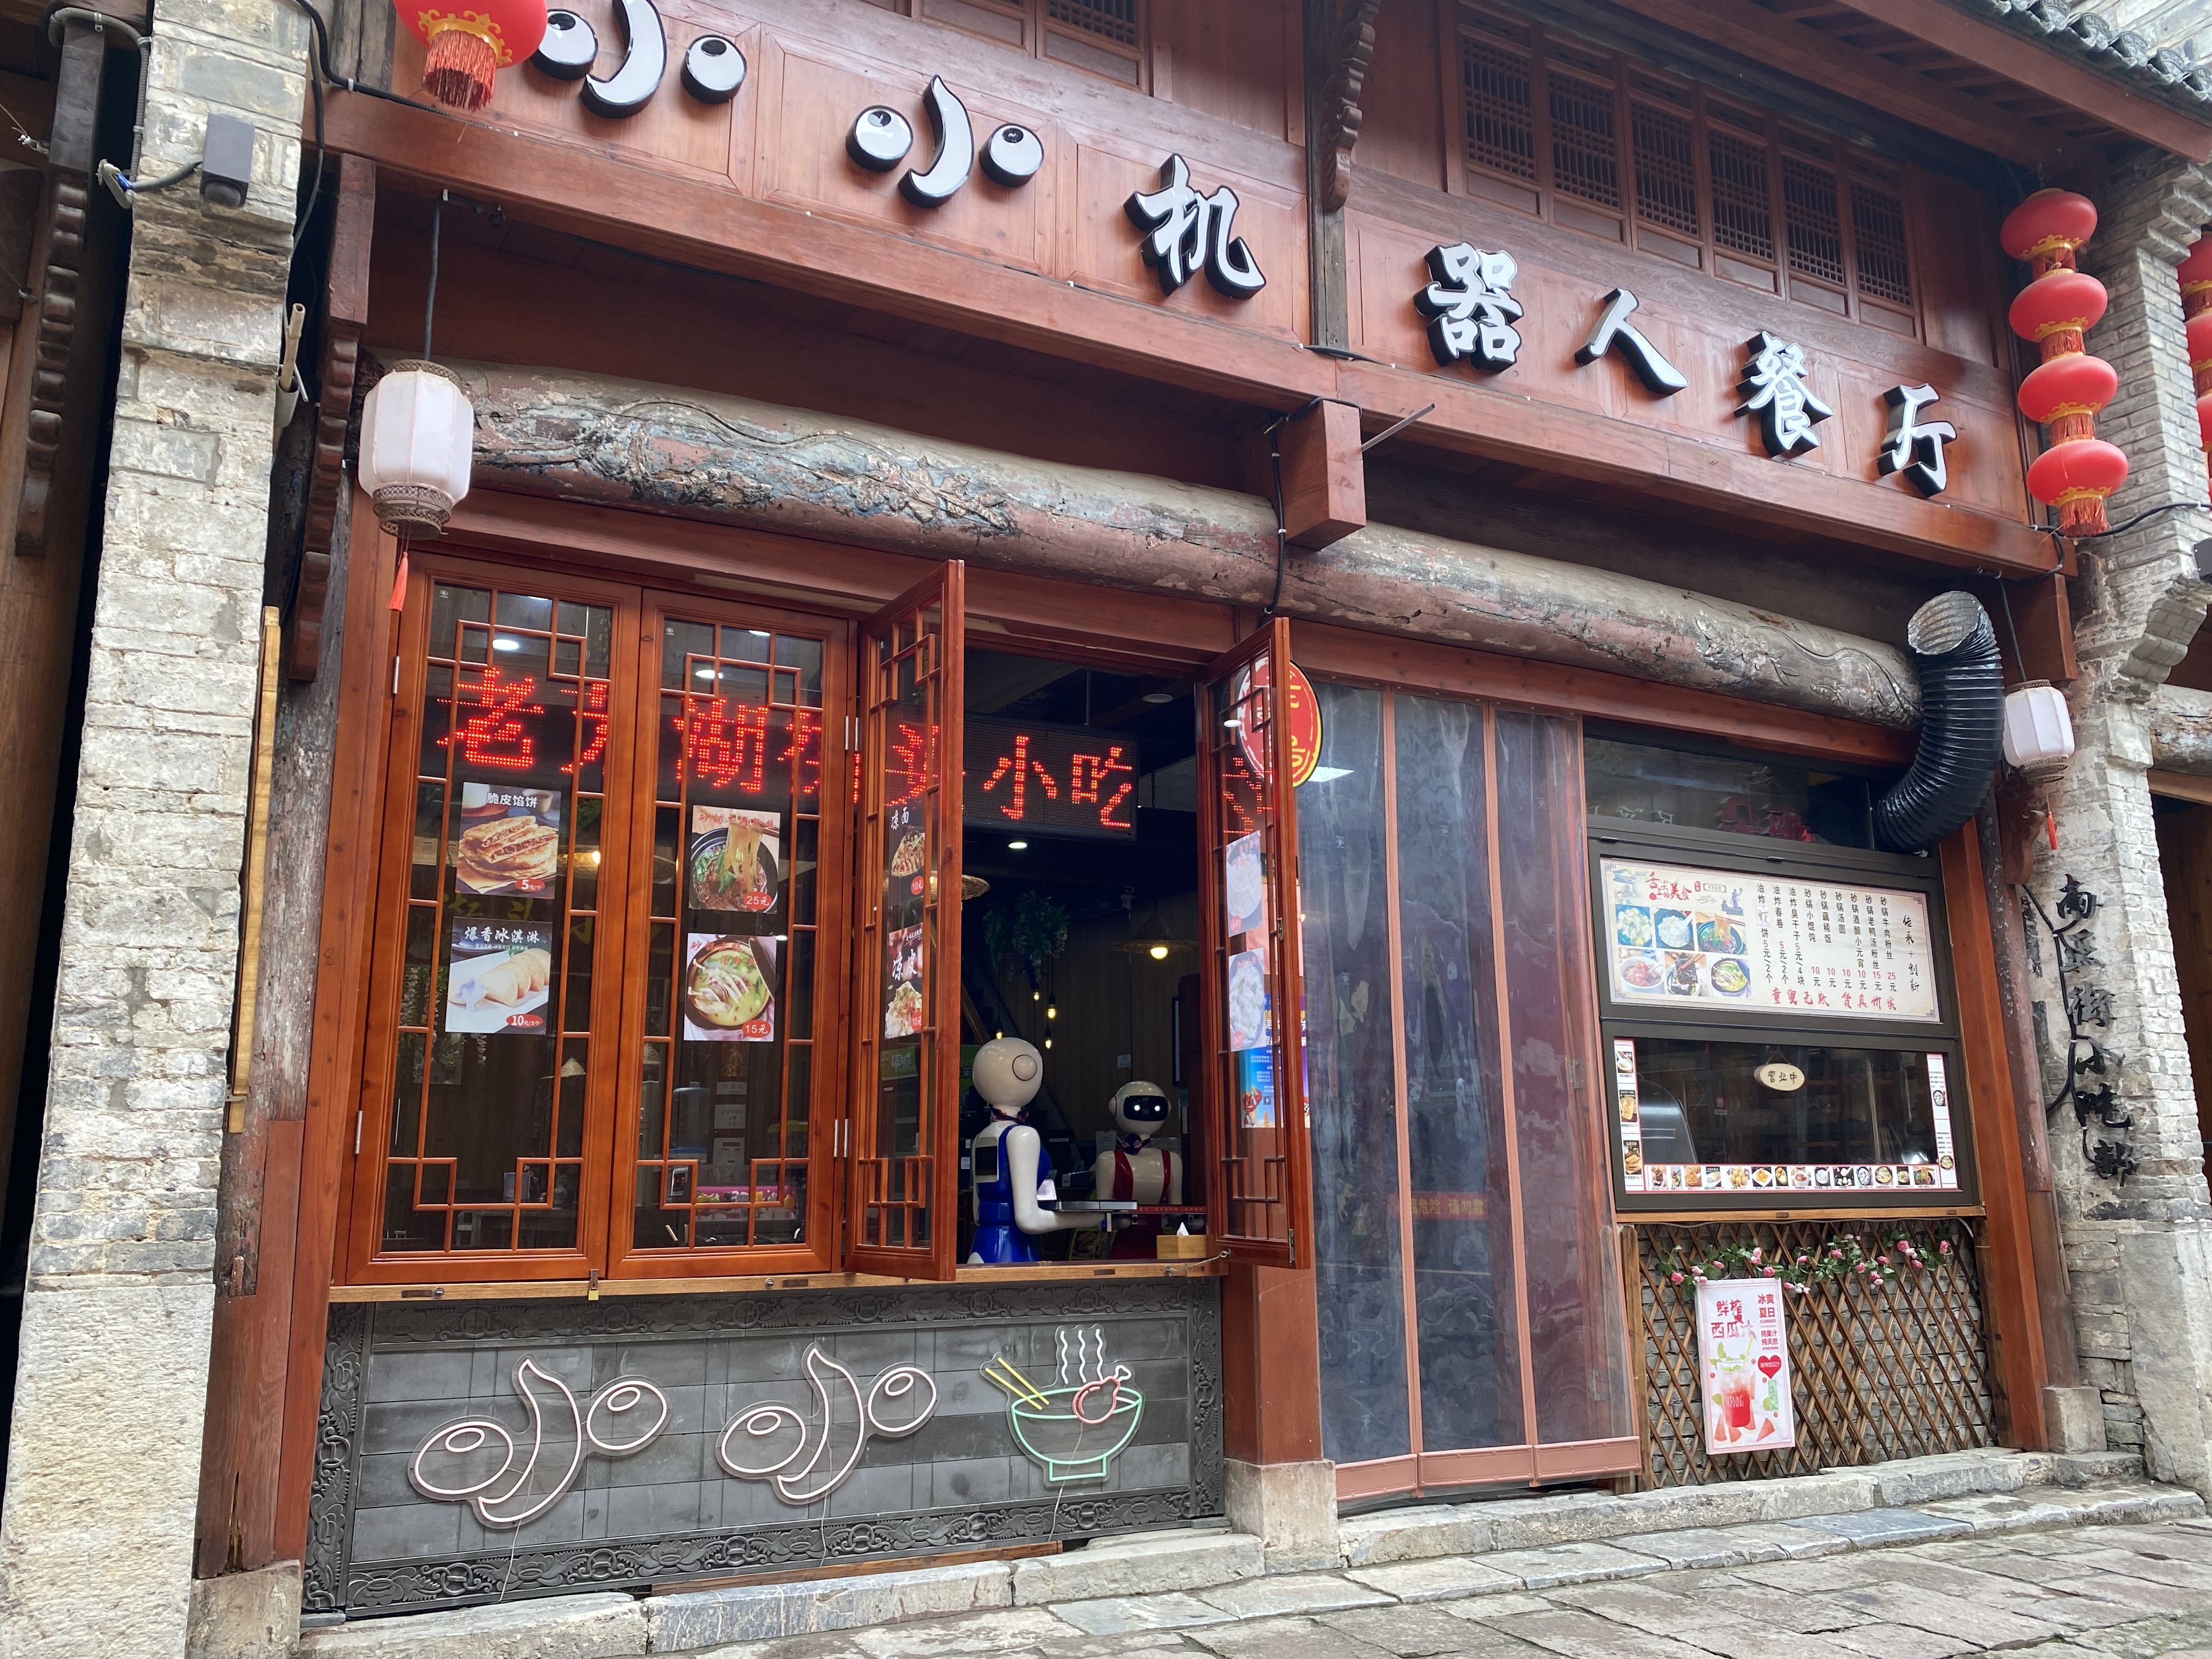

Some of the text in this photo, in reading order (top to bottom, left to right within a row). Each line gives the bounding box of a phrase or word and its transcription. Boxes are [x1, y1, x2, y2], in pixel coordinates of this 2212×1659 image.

[487, 792, 538, 808] 脆皮馅饼
[891, 806, 909, 831] 凉面
[521, 879, 541, 890] 5元/个
[912, 879, 923, 891] 10元
[746, 896, 770, 906] 25元
[1773, 885, 1783, 928] 油炸春卷
[1789, 887, 1801, 940] 油炸臭干子
[464, 926, 540, 944] 爆香冰淇淋
[1804, 888, 1821, 986] 砂锅小馄饨 10元
[1835, 892, 1852, 989] 砂锅汤圆 10元
[1865, 895, 1882, 991] 砂锅老鸭汤粉丝 15元
[1880, 896, 1897, 992] 砂锅牛肉粉丝 25元
[892, 949, 918, 981] 凉皮
[1827, 968, 1836, 988] 10元
[1858, 970, 1867, 990] 10元
[511, 1015, 540, 1026] 10元/5个
[745, 1024, 768, 1034] 15元
[1768, 1070, 1797, 1084] 营业中
[1448, 1198, 1488, 1216] 请勿靠
[1716, 1299, 1743, 1317] 鲜榨
[1757, 1293, 1775, 1305] 冰爽
[1759, 1307, 1775, 1318] 夏日
